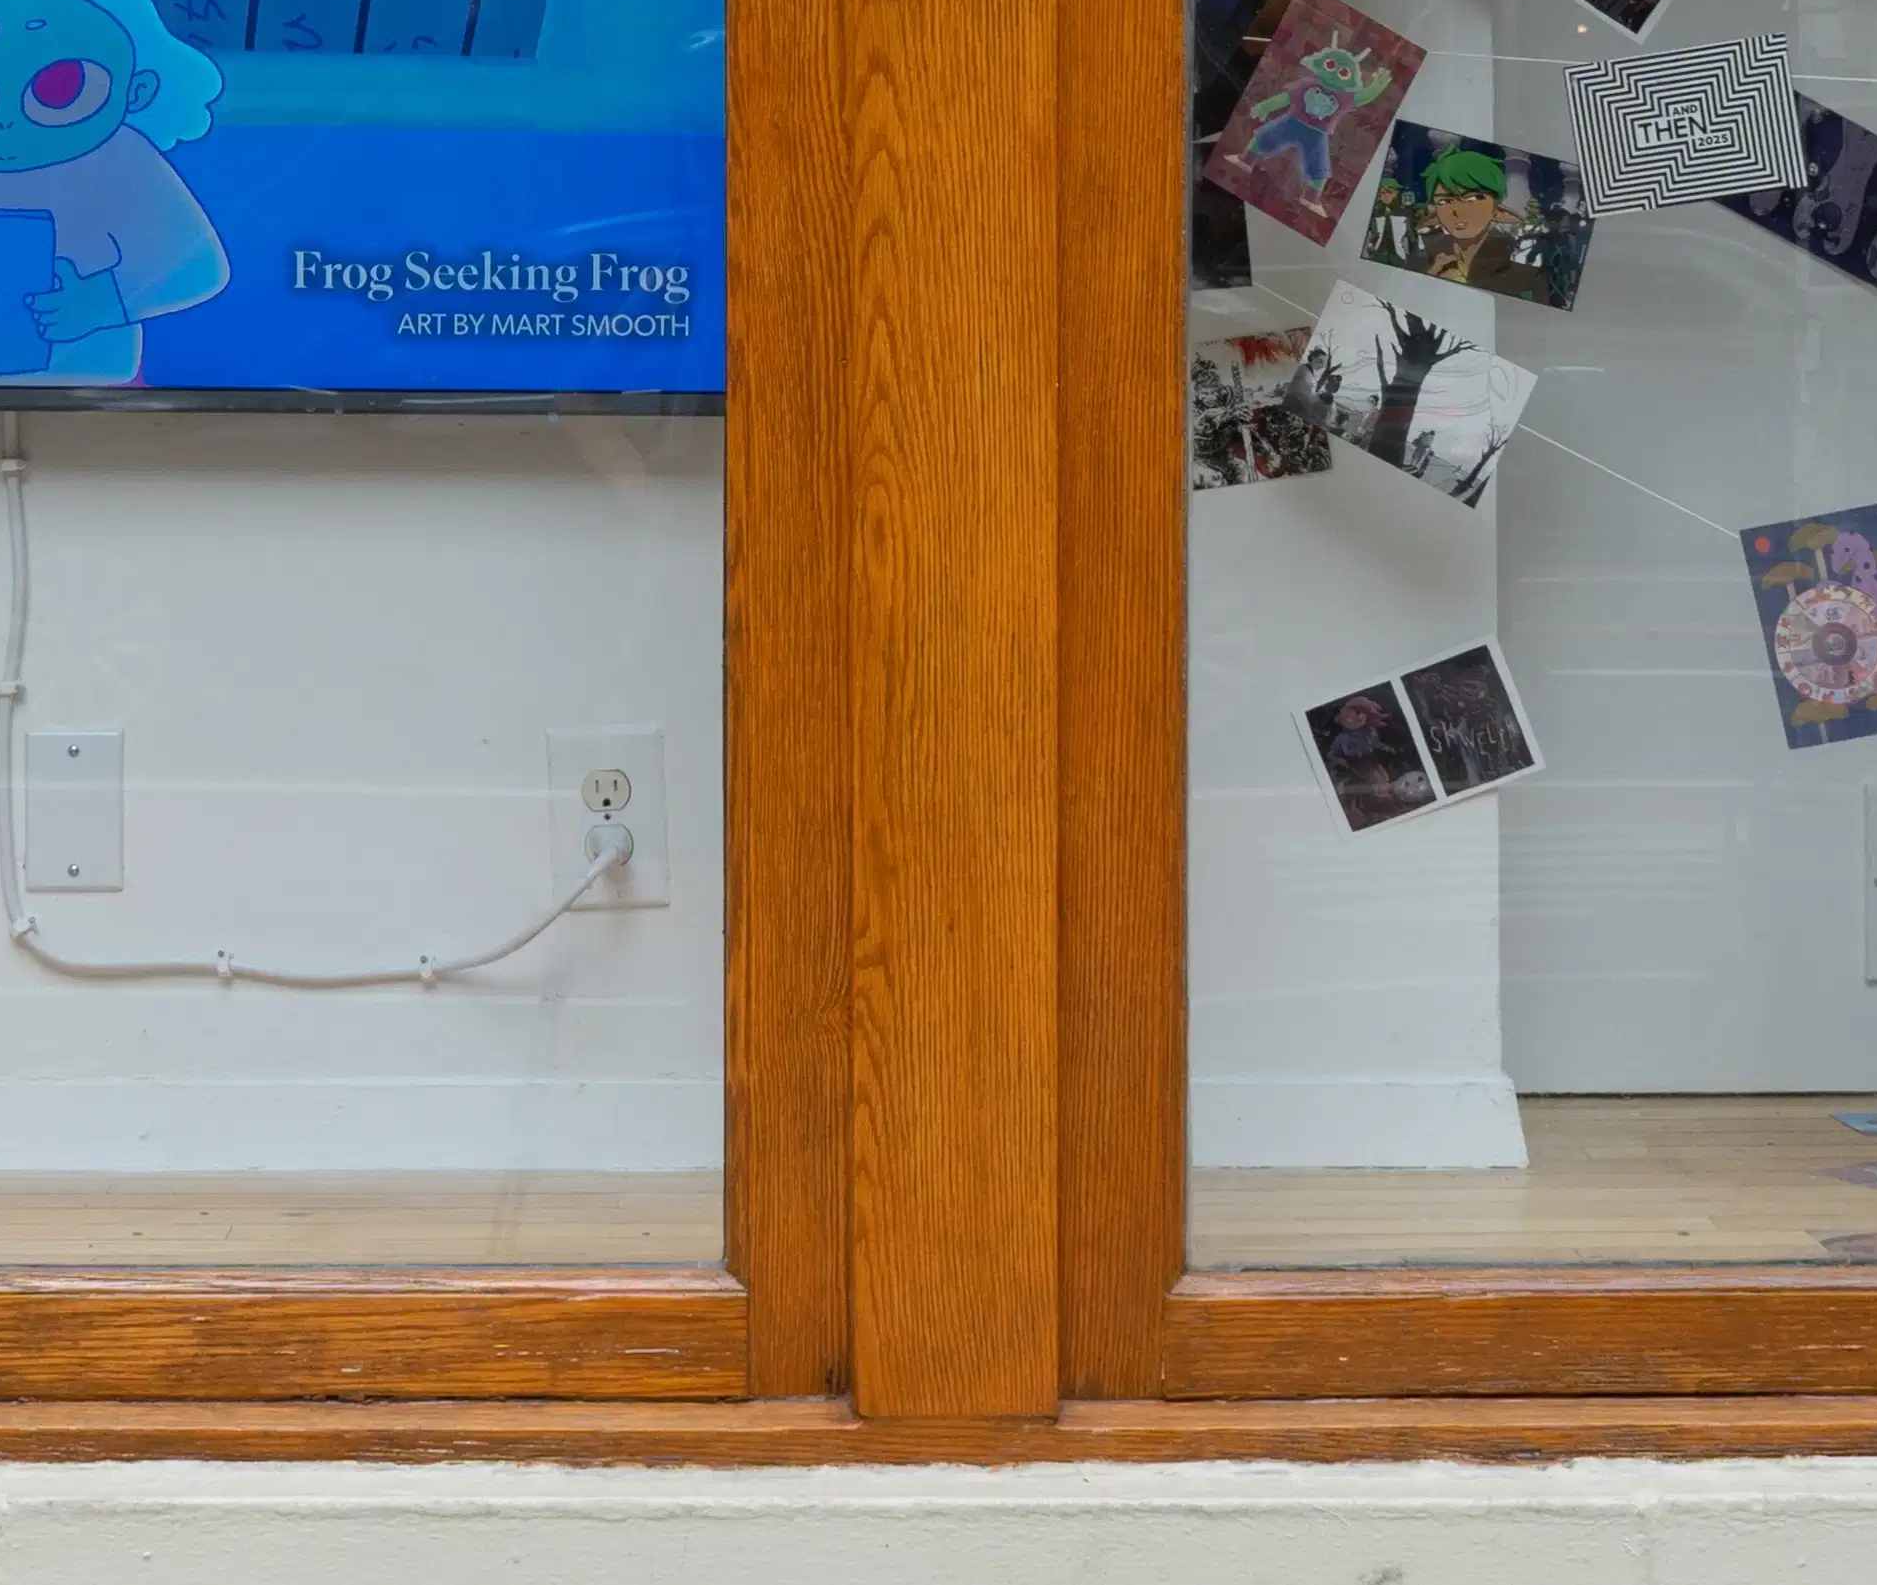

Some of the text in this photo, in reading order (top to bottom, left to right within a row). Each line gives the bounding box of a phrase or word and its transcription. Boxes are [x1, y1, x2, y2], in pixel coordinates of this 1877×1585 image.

[1671, 104, 1699, 116] AND
[1637, 115, 1707, 143] THEN
[1697, 133, 1729, 147] 2025
[294, 250, 690, 304] Frog Seeking Frog
[398, 313, 689, 337] ART BY MART SMOOTH
